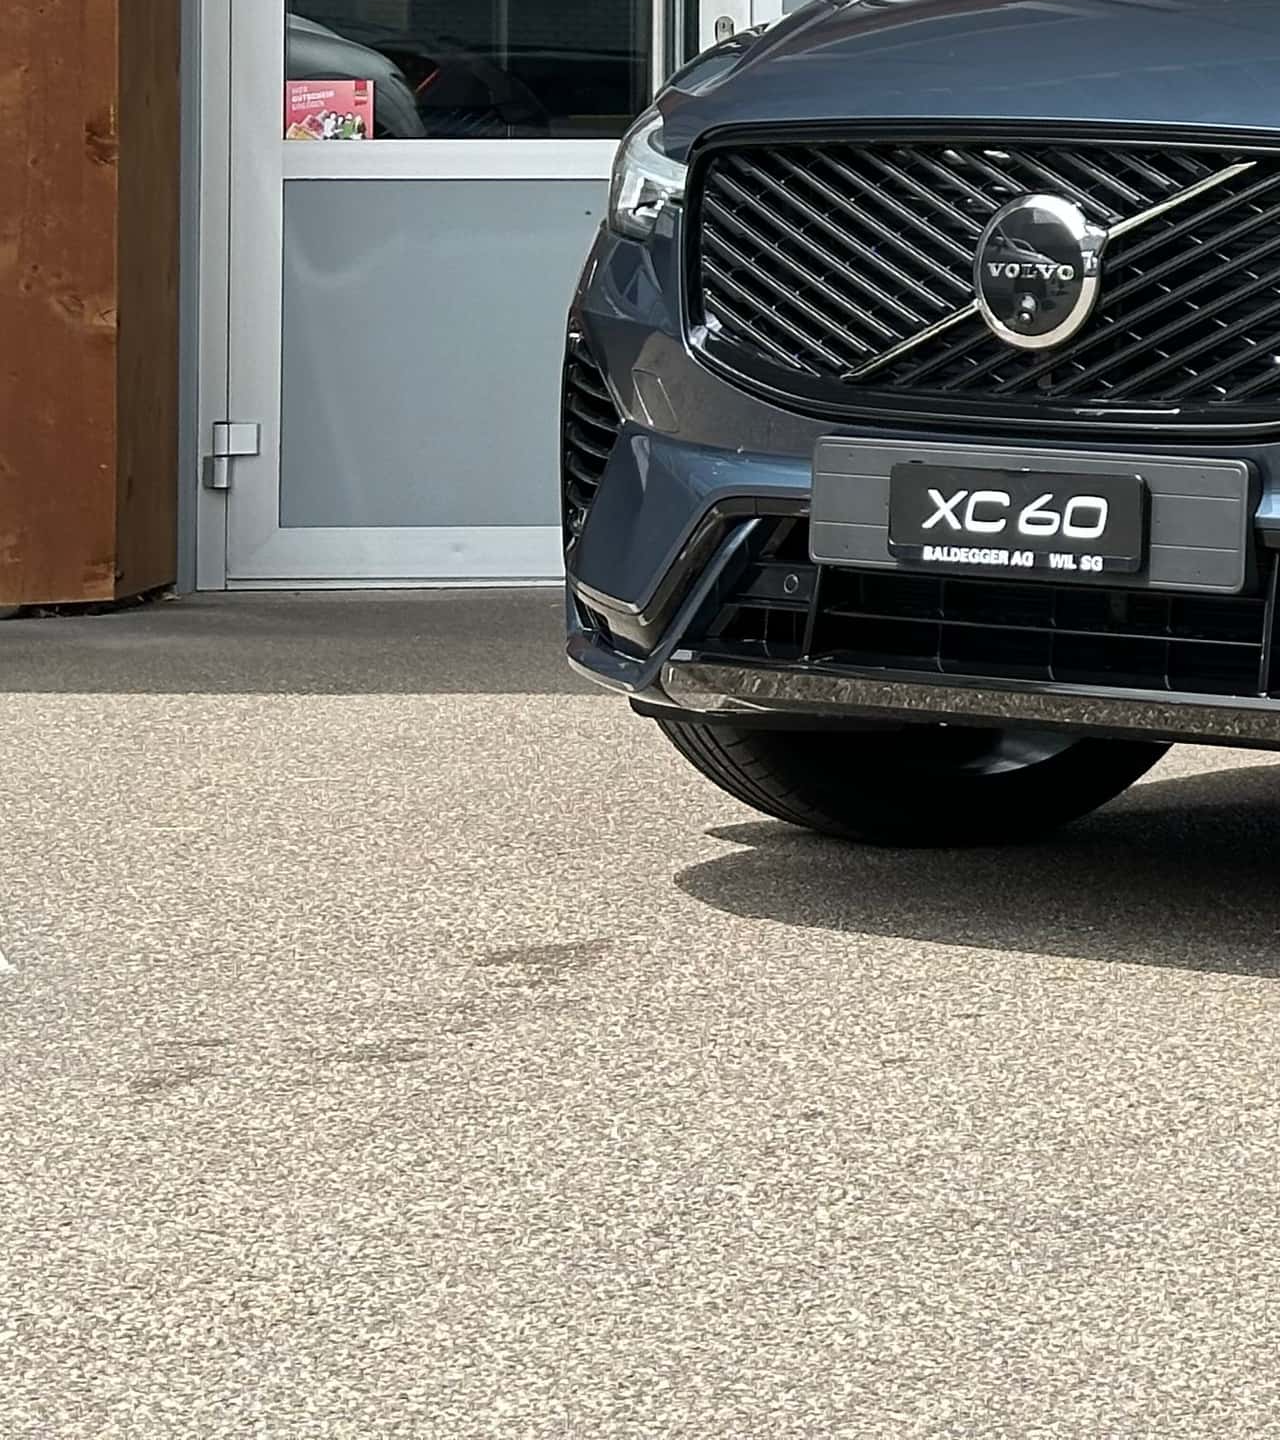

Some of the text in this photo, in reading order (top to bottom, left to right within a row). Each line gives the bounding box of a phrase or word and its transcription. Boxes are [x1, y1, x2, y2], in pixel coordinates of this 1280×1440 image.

[987, 262, 1075, 281] VOLVO
[923, 545, 1104, 572] BALDEGGER AG WIL SG
